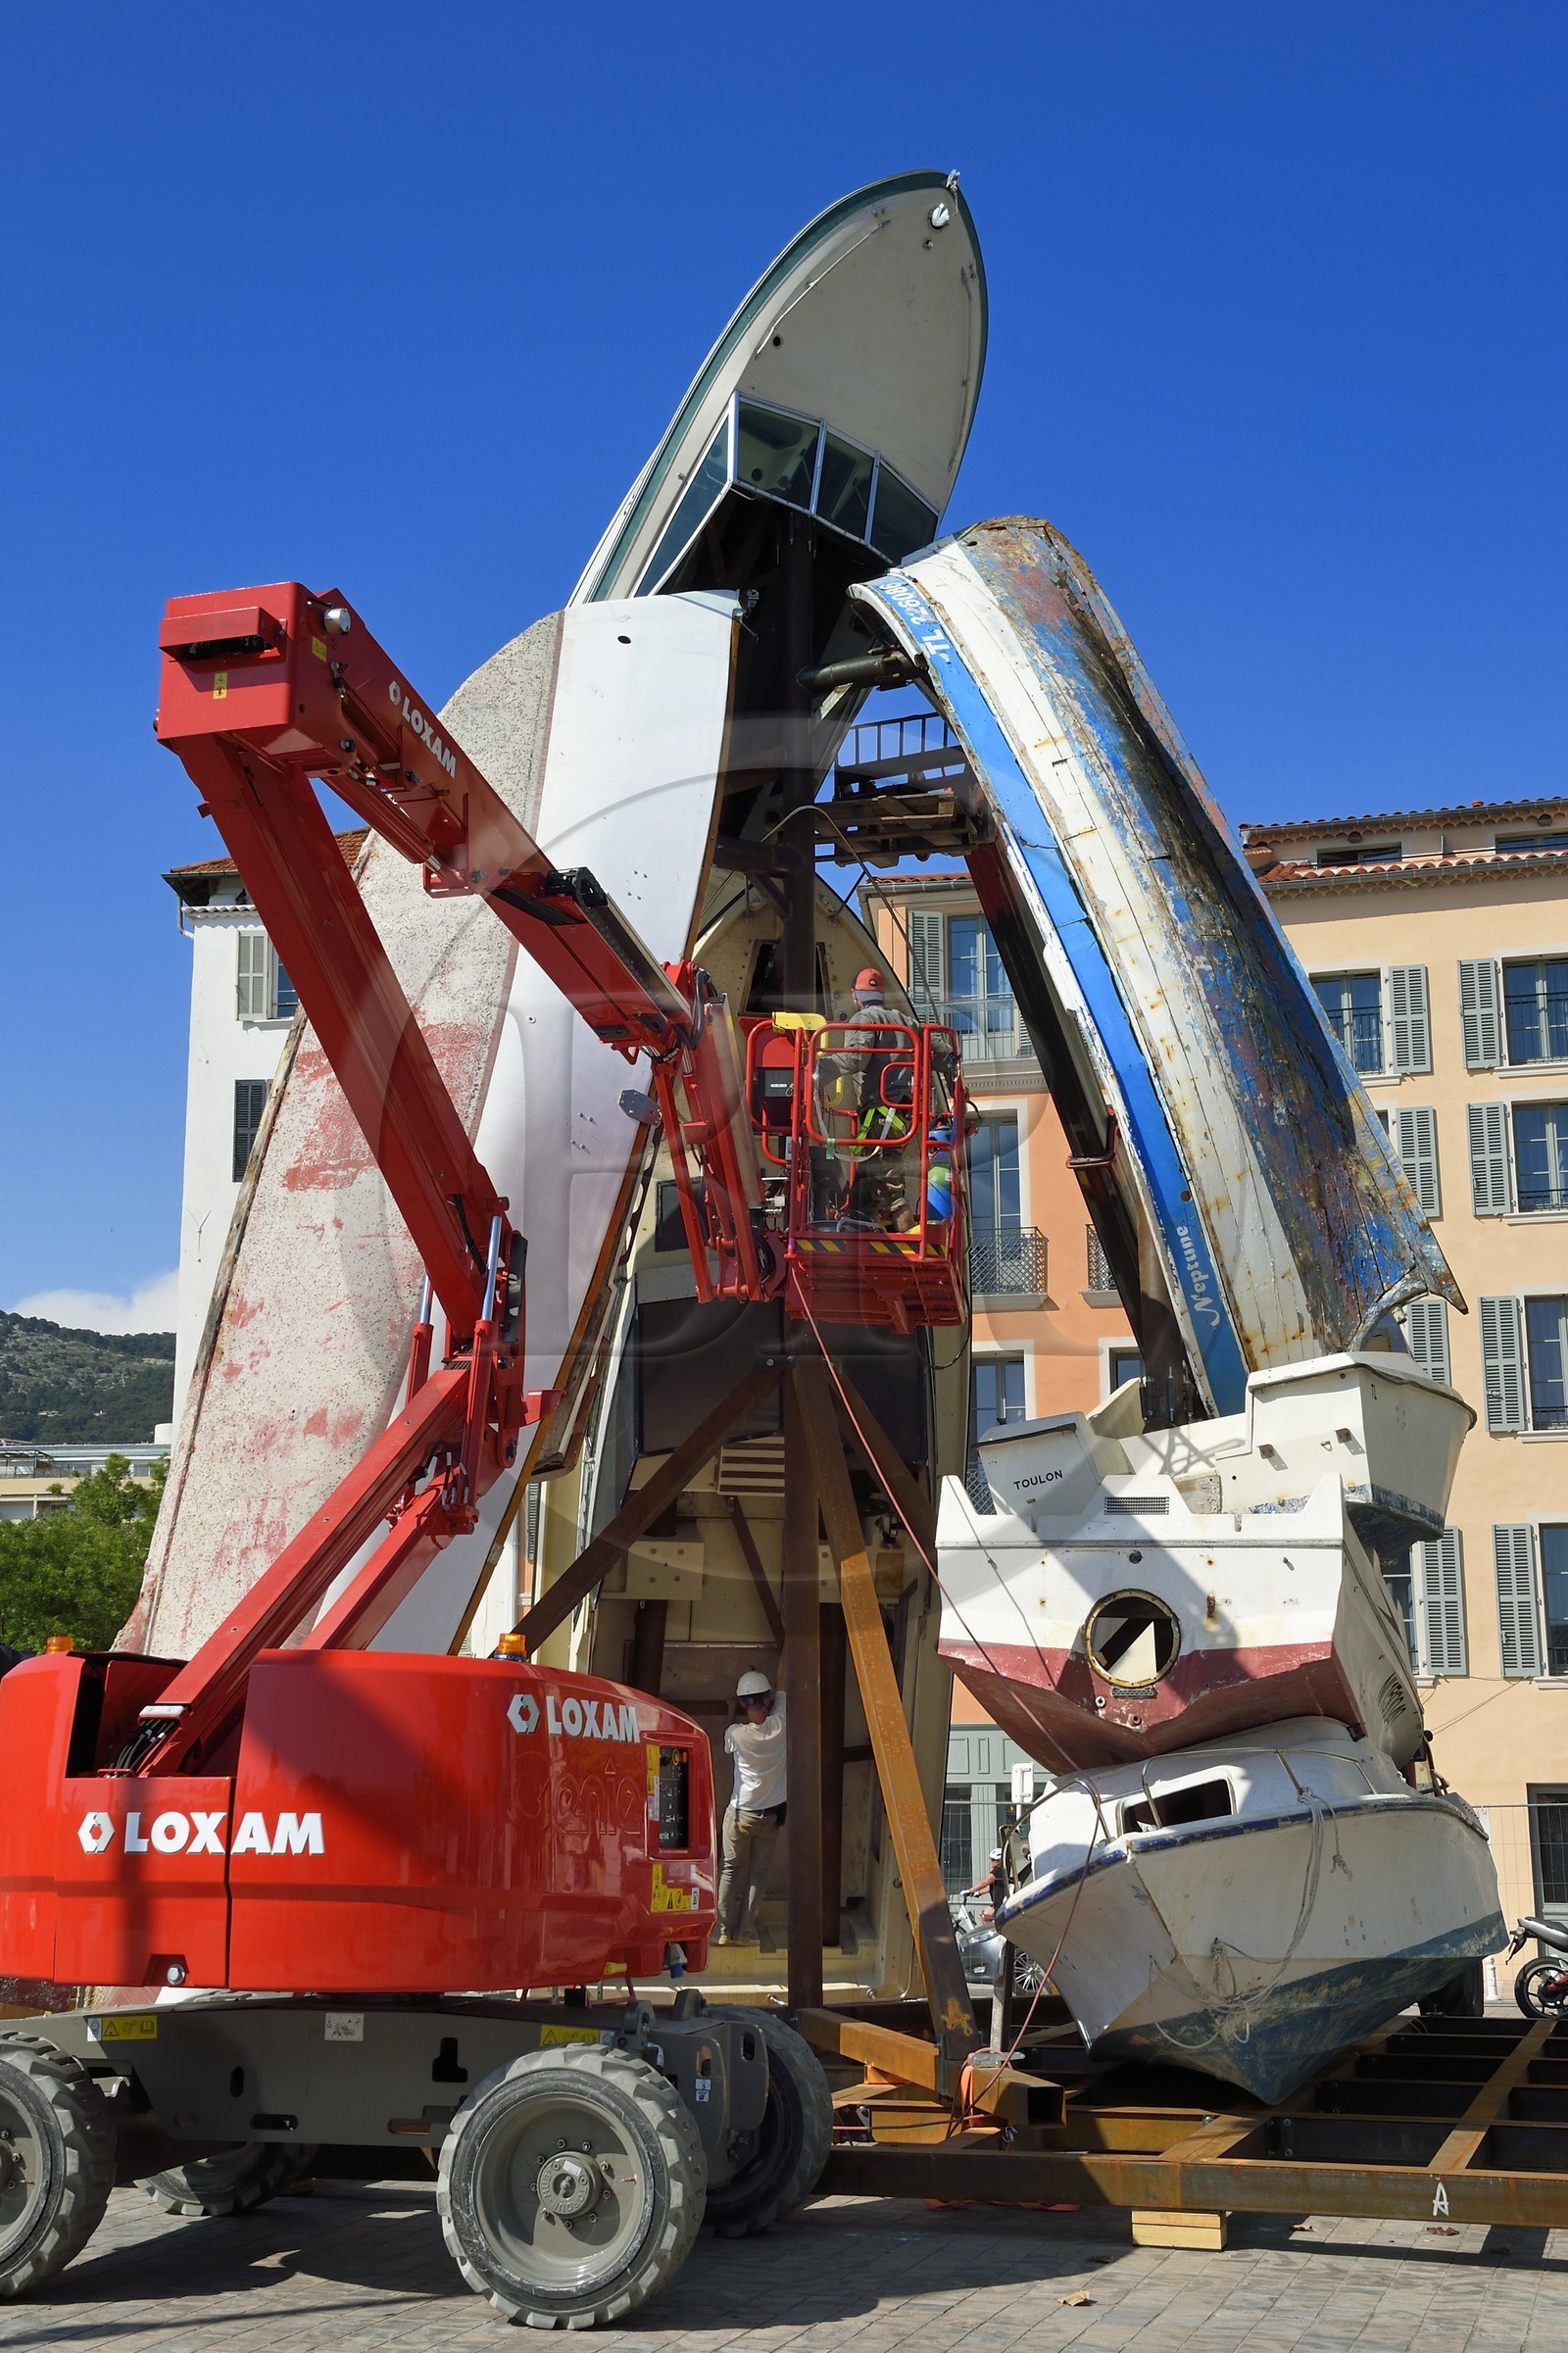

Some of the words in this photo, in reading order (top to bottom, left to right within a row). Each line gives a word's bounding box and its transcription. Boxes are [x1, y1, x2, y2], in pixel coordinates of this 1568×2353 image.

[922, 629, 951, 655] TL
[402, 696, 457, 779] LOXAM
[1176, 1225, 1220, 1327] Neptune
[1013, 1469, 1063, 1490] TOULON
[546, 1694, 640, 1743] LOXAM
[123, 1811, 325, 1855] LOXAM
[1432, 2181, 1449, 2217] A
